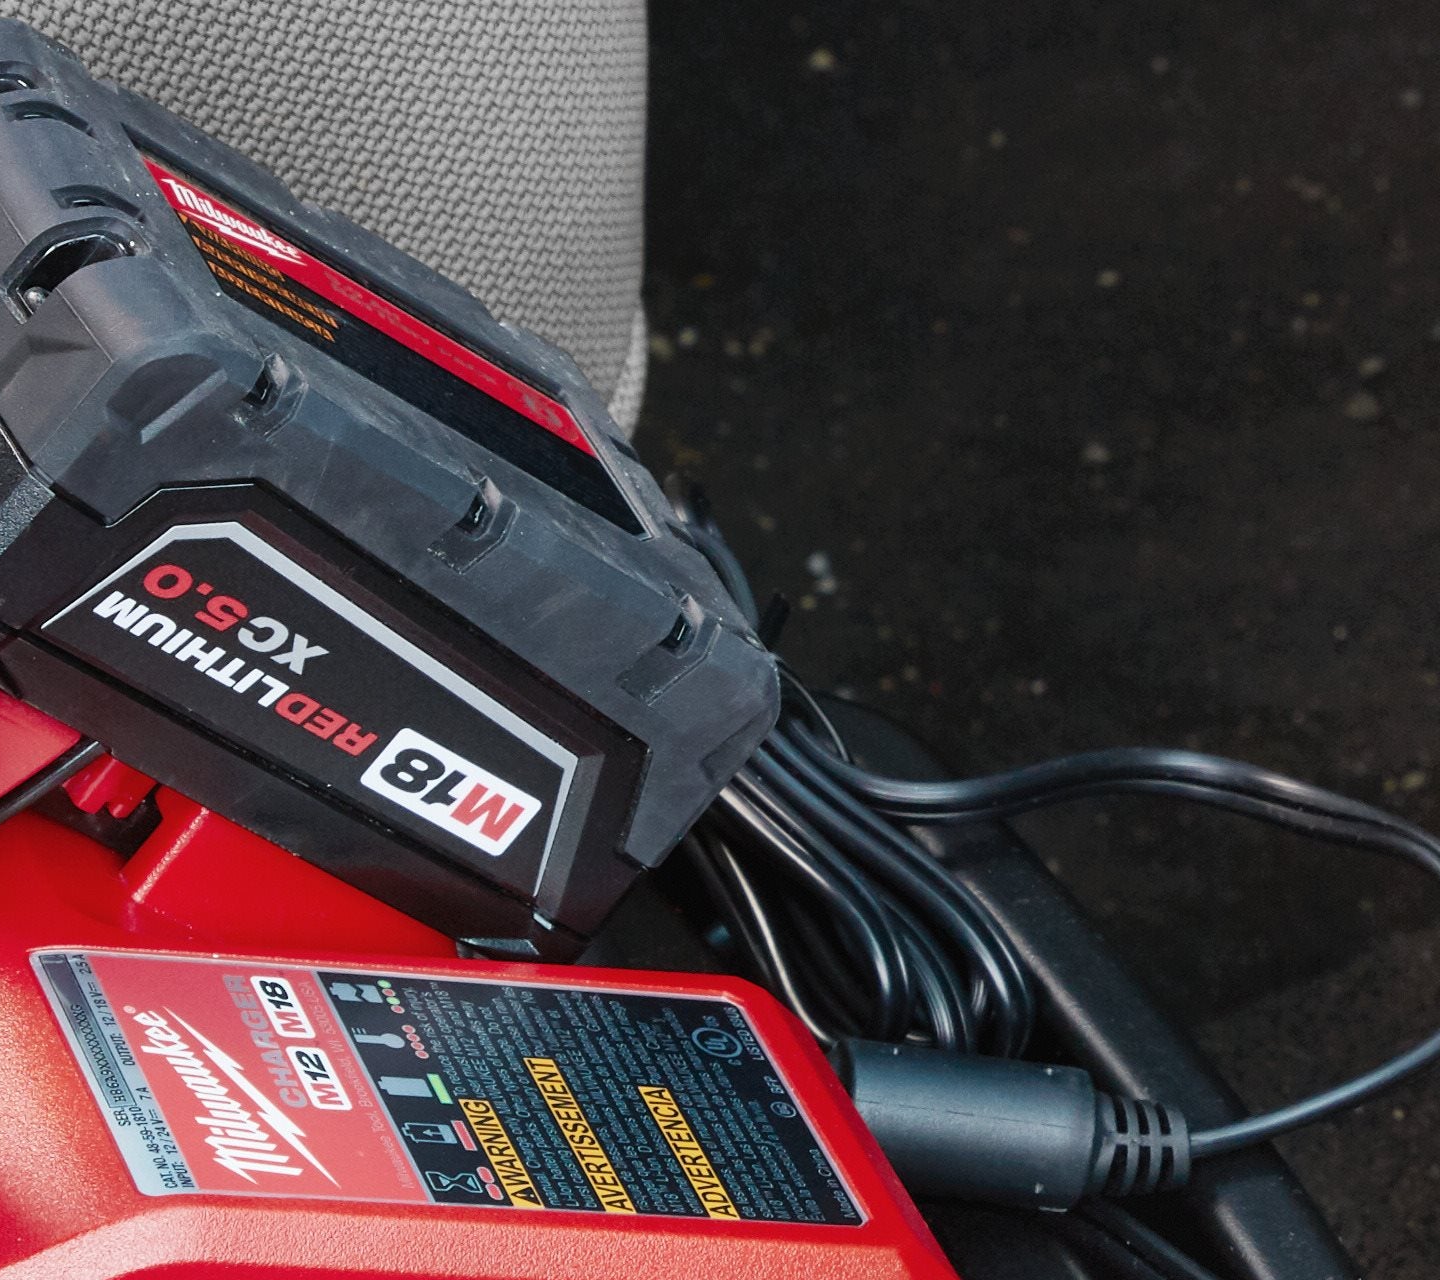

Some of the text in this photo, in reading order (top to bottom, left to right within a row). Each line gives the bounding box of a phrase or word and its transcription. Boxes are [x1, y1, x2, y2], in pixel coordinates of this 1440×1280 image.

[160, 178, 302, 260] Milwaukee
[142, 564, 329, 675] XC5.0
[92, 590, 526, 842] M18 REDLITHIUM
[411, 1012, 428, 1020] of
[419, 1023, 436, 1037] risk
[448, 1011, 465, 1027] and
[110, 1033, 135, 1065] OUTPUT:
[219, 973, 310, 1108] CHARGER
[256, 979, 344, 1105] M12 M18
[430, 1040, 445, 1052] the
[441, 1035, 462, 1054] read
[438, 1055, 461, 1084] reduce
[454, 1056, 471, 1076] must
[487, 1058, 503, 1066] of
[128, 1010, 303, 1184] Milwaukee
[453, 1087, 467, 1096] To
[467, 1079, 486, 1097] user
[471, 1059, 510, 1114] MILWAUKEE
[504, 1116, 523, 1134] only
[527, 1060, 632, 1211] AVERTISSEMENT
[534, 1111, 568, 1148] personal
[129, 1107, 178, 1188] CAT. NO. 48-59-1810
[463, 1102, 529, 1186] WARNING
[516, 1137, 541, 1168] Charge
[645, 1089, 736, 1217] ADVERTENCIA
[172, 1162, 194, 1187] INPUT:
[540, 1150, 565, 1180] battery
[558, 1150, 584, 1183] causing
[574, 1186, 597, 1208] burst
